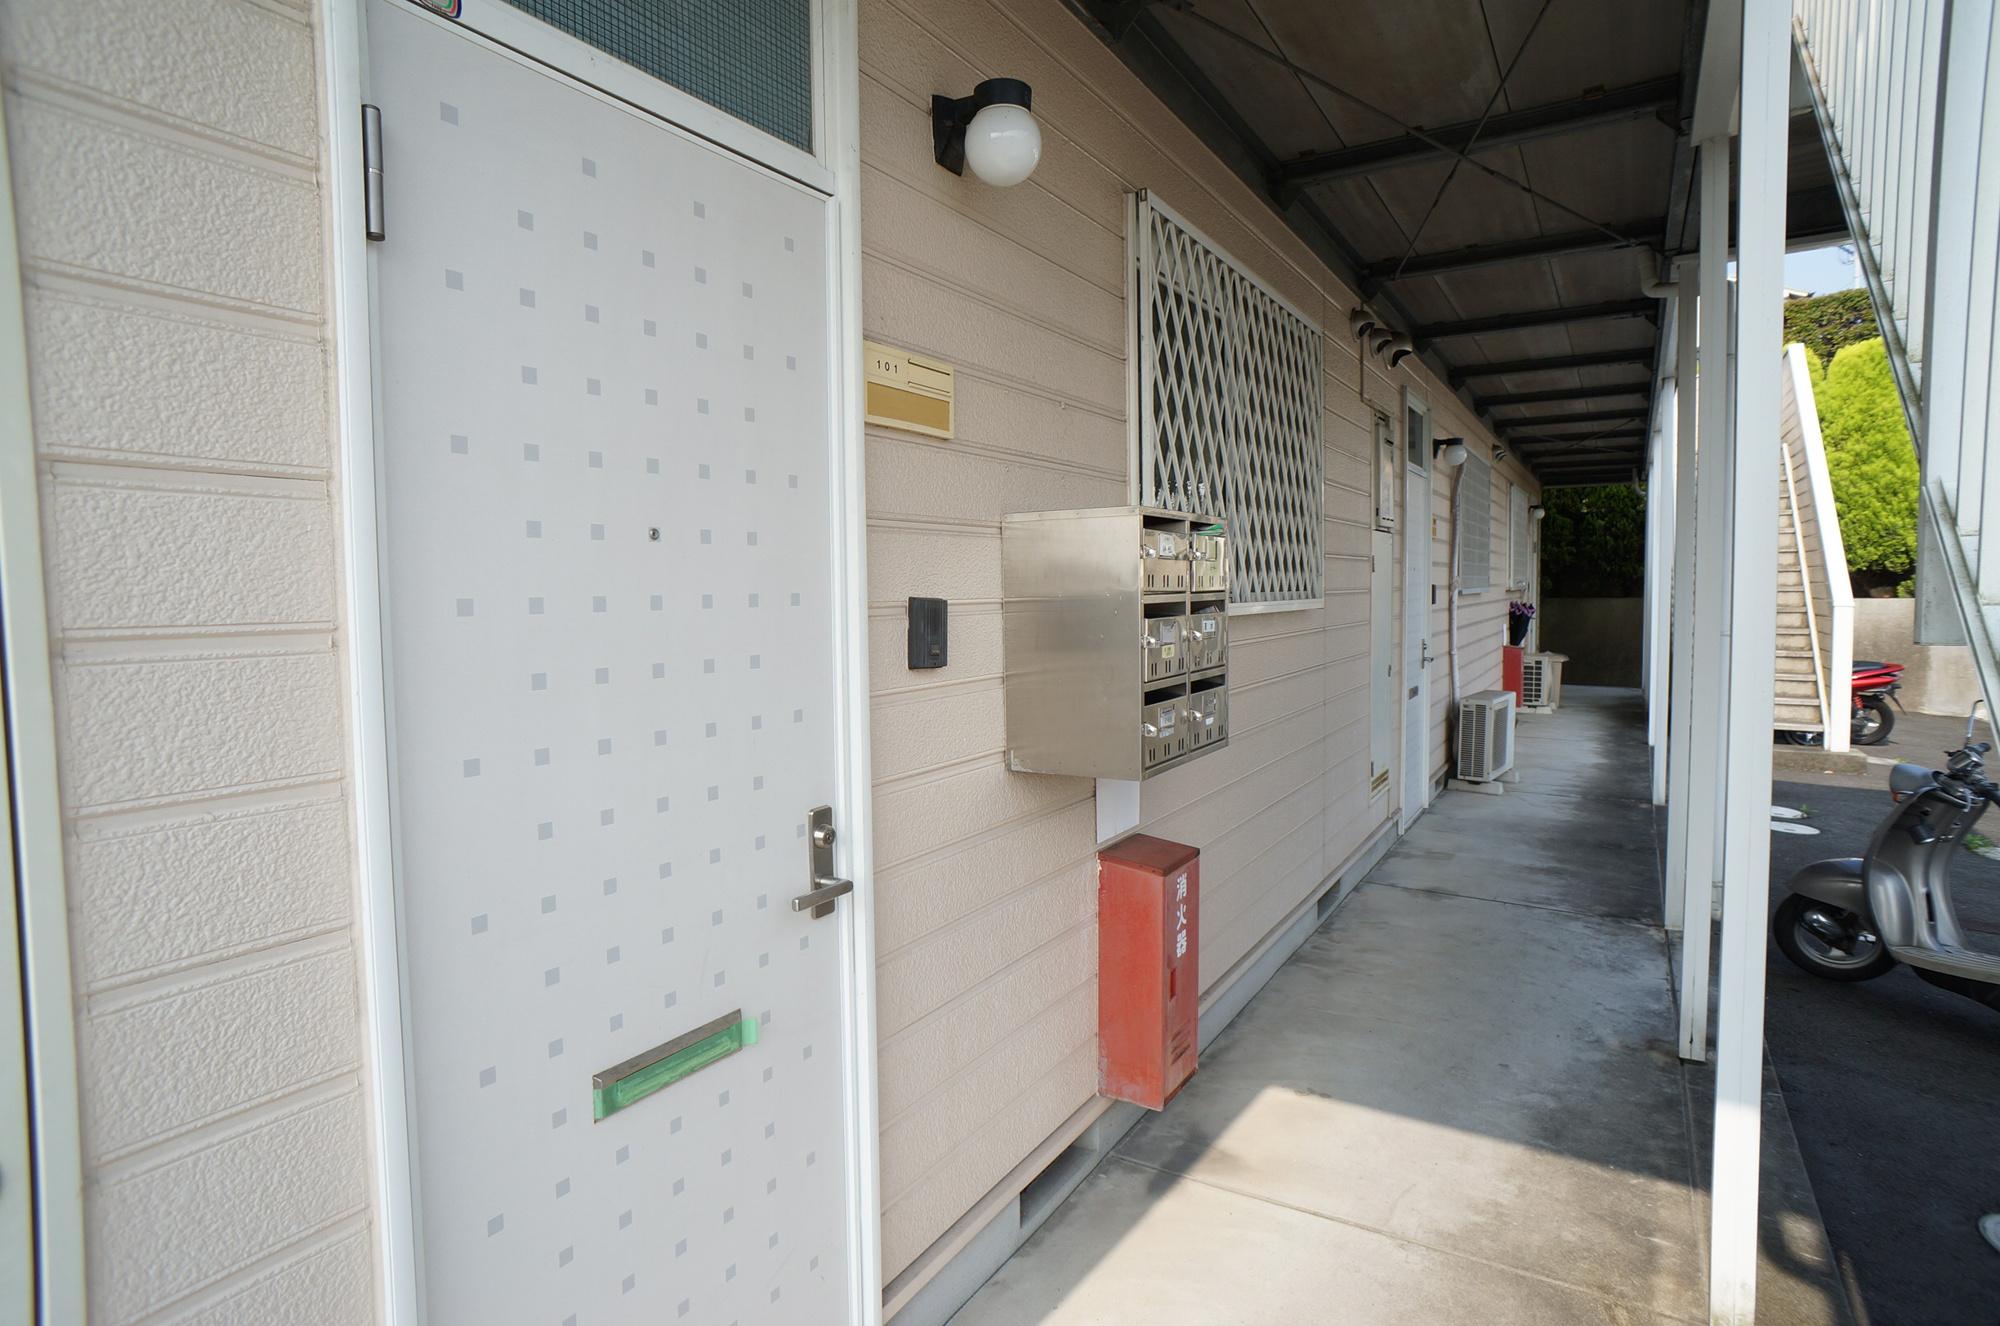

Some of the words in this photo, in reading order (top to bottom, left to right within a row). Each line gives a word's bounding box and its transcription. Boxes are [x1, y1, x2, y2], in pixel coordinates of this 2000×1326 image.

[877, 360, 898, 374] 101
[1176, 872, 1187, 958] 消火器
